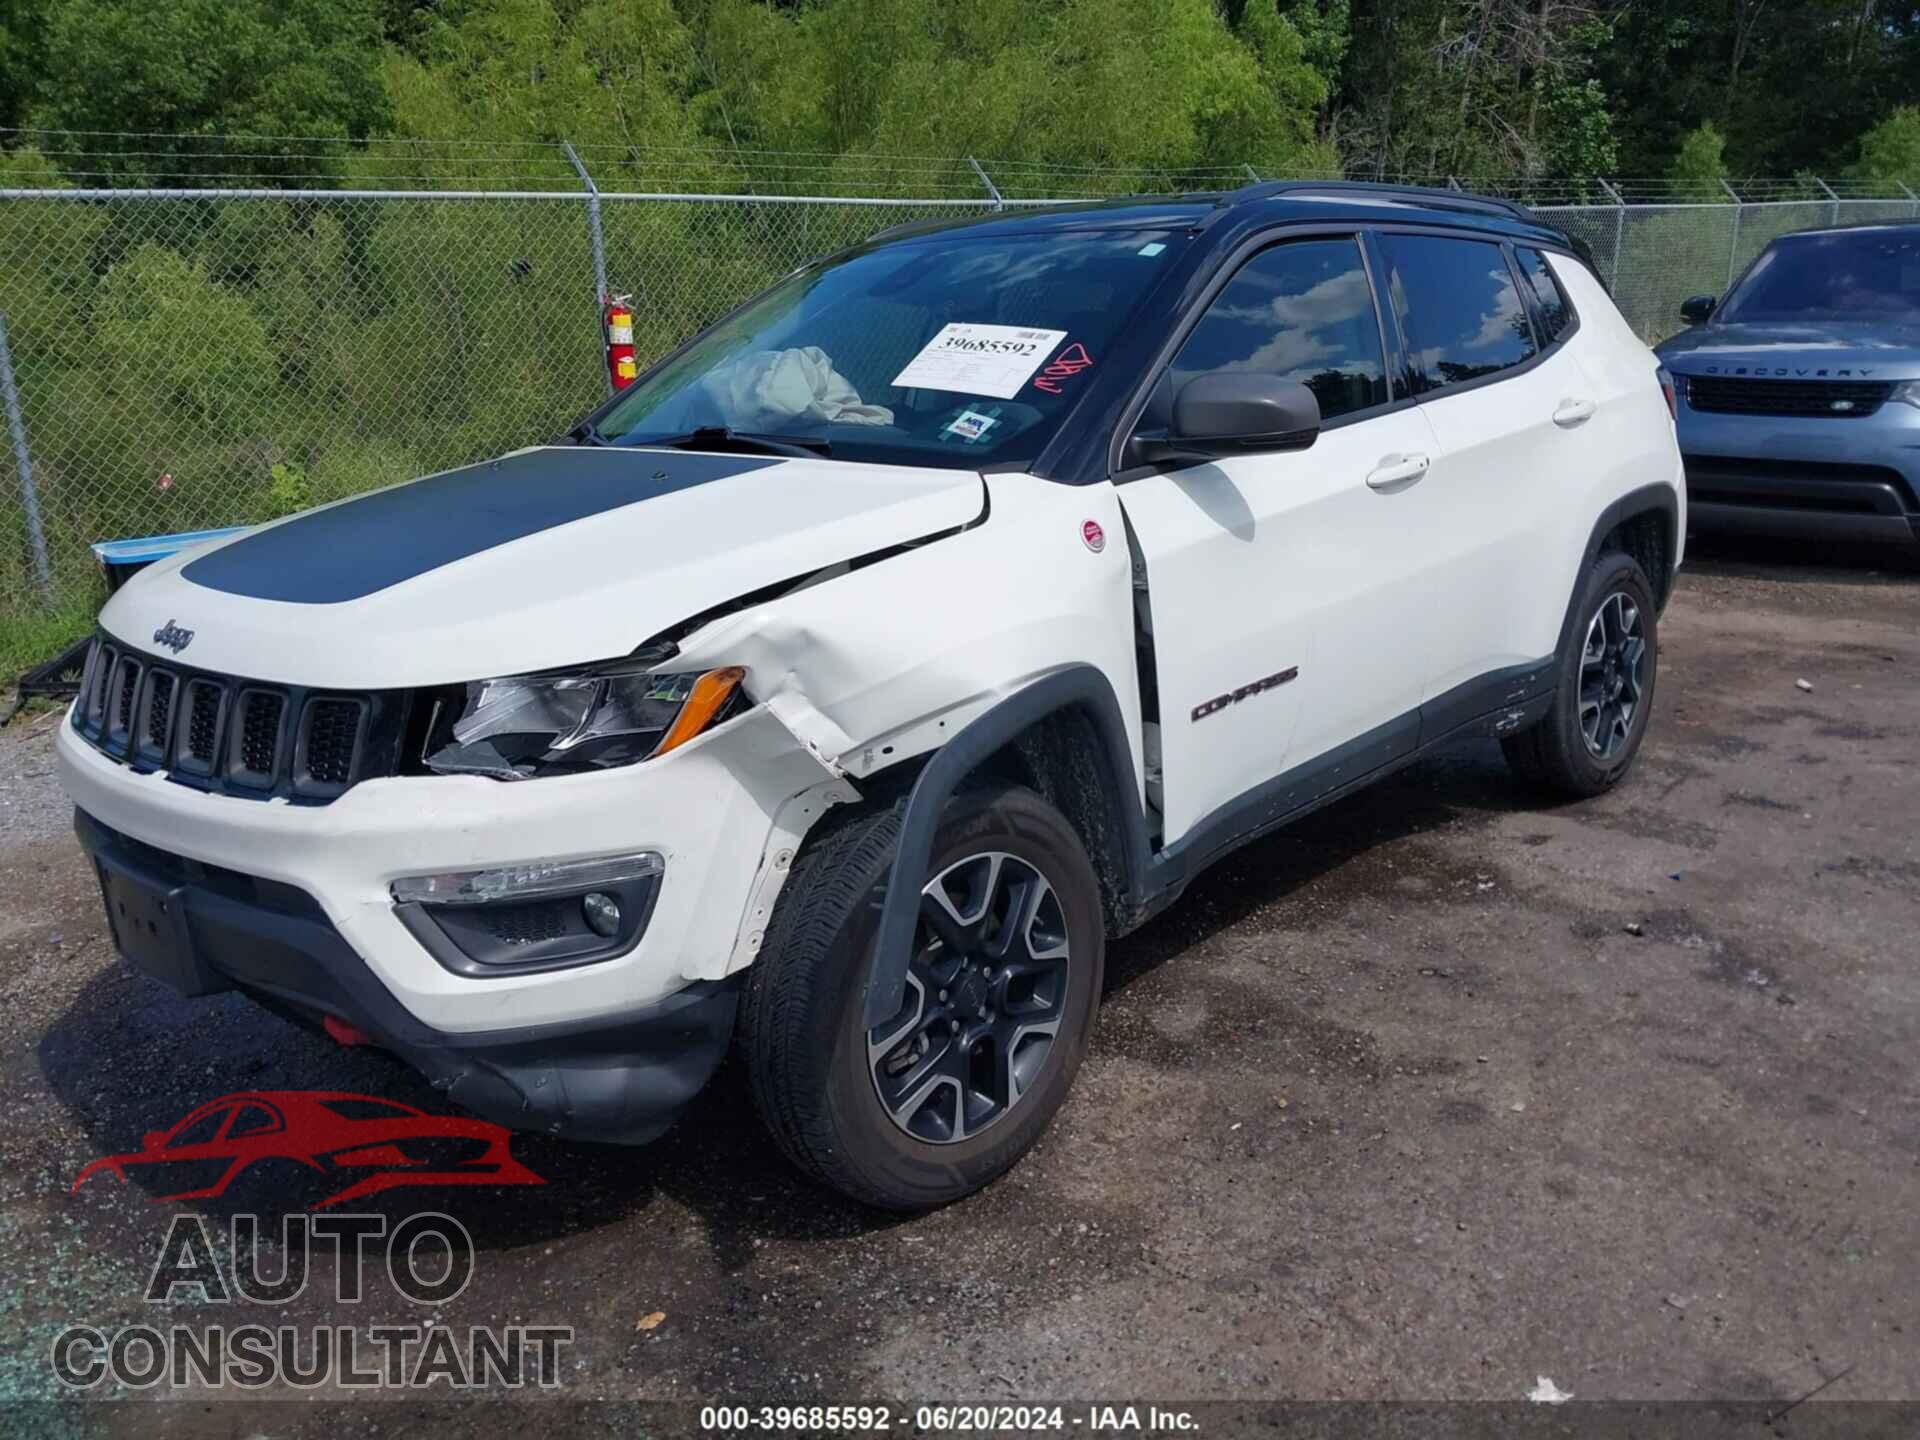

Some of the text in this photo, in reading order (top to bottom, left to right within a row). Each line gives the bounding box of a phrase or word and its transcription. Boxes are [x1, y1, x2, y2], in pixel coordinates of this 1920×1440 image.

[937, 337, 1037, 356] 39685592
[1705, 365, 1873, 377] DISCOVERY
[153, 618, 195, 655] Jeep
[1191, 664, 1299, 722] COMPASS
